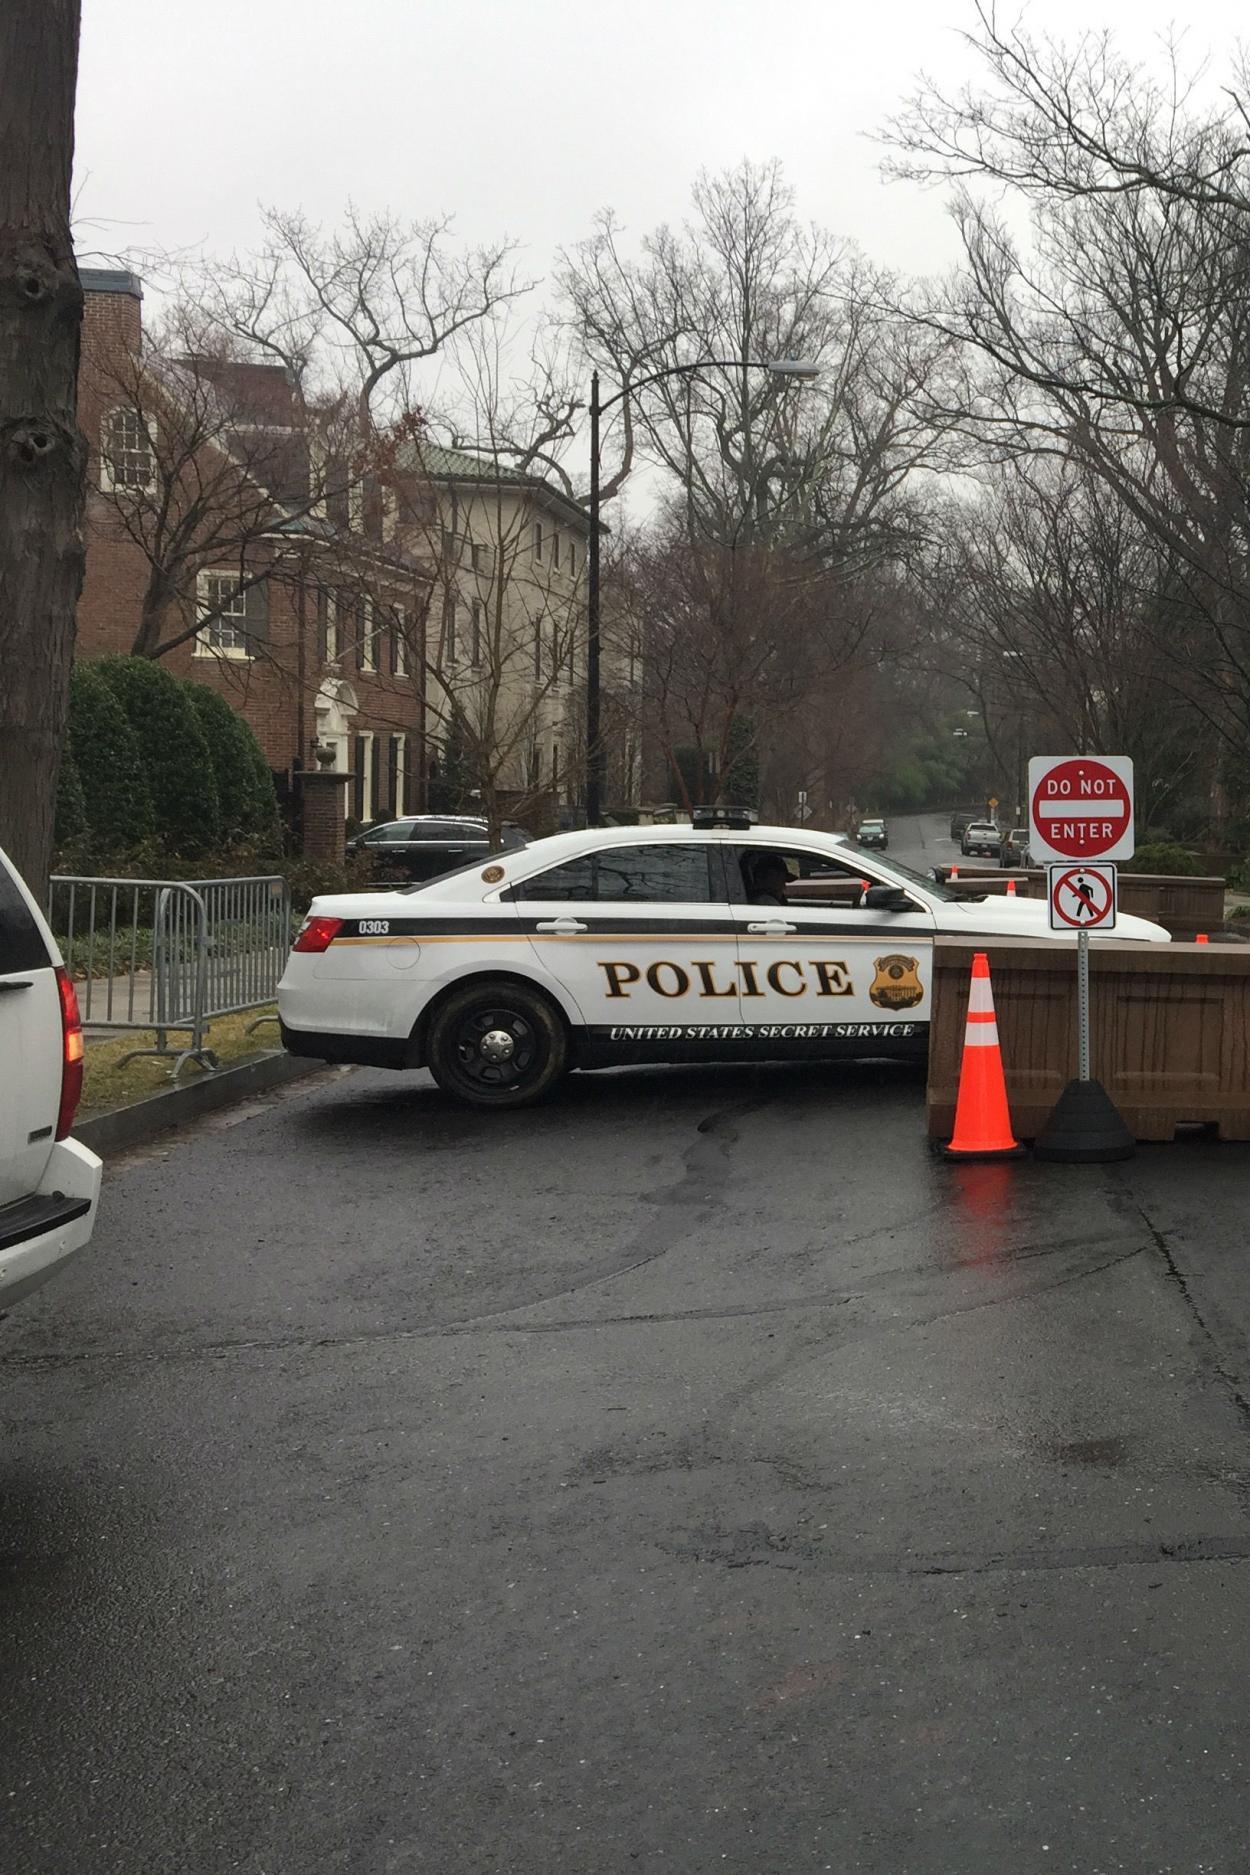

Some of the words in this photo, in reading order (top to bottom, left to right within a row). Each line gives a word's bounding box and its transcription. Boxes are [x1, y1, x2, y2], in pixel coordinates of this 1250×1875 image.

[1047, 779, 1071, 795] DO
[1080, 779, 1116, 795] NOT
[1051, 823, 1113, 839] ENTER
[359, 921, 389, 934] 0303
[597, 960, 855, 998] POLICE
[610, 1026, 682, 1040] UNITED
[685, 1025, 754, 1039] STATES
[758, 1024, 830, 1038] SECRET
[834, 1023, 915, 1037] SERVICE
